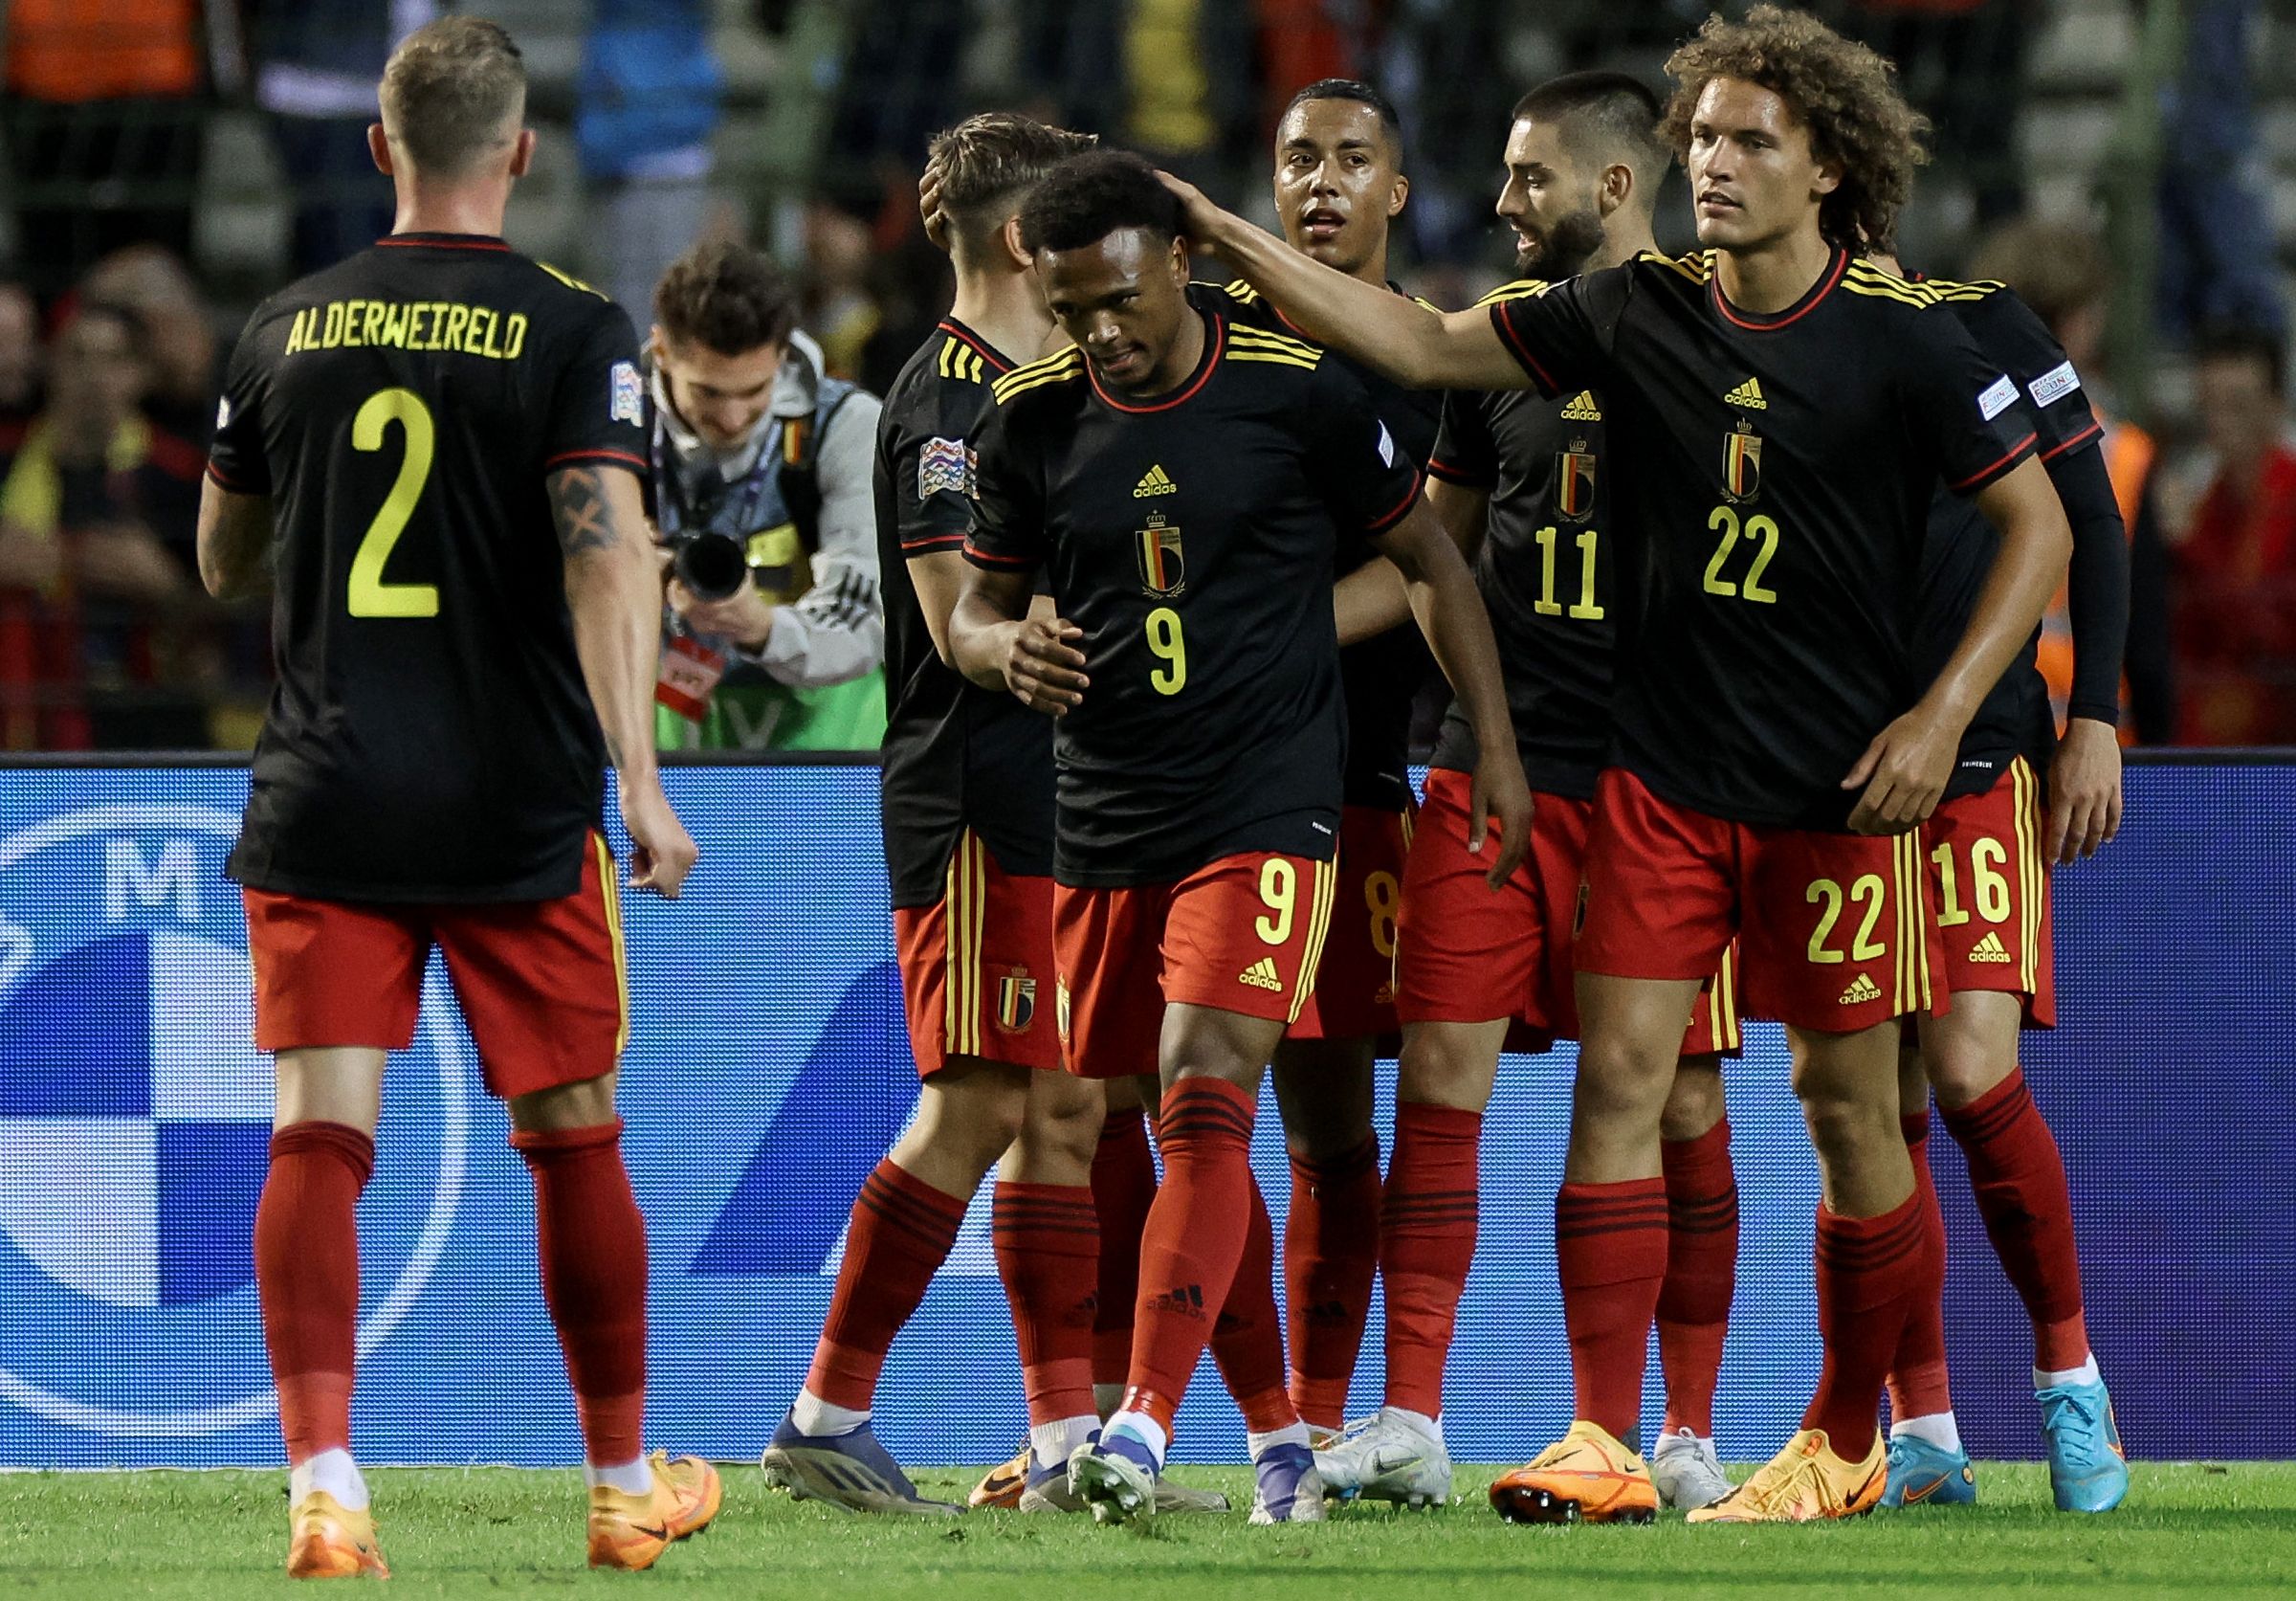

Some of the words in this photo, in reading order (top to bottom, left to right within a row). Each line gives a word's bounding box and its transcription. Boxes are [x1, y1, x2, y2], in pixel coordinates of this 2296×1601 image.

[285, 300, 527, 359] ALDERWEIRELD
[1560, 409, 1601, 421] adidas
[1725, 393, 1767, 410] adidas
[348, 388, 439, 617] 2
[1133, 483, 1178, 498] adidas
[1534, 527, 1604, 620] 11
[1704, 505, 1779, 603] 22
[1146, 608, 1186, 696] 9
[1255, 857, 1296, 945] 9
[1364, 871, 1400, 958] 8
[1806, 874, 1886, 964] 22
[1932, 837, 2010, 927] 16
[1239, 973, 1283, 991] adidas
[1839, 989, 1882, 1005] adidas
[1969, 950, 2011, 964] adidas
